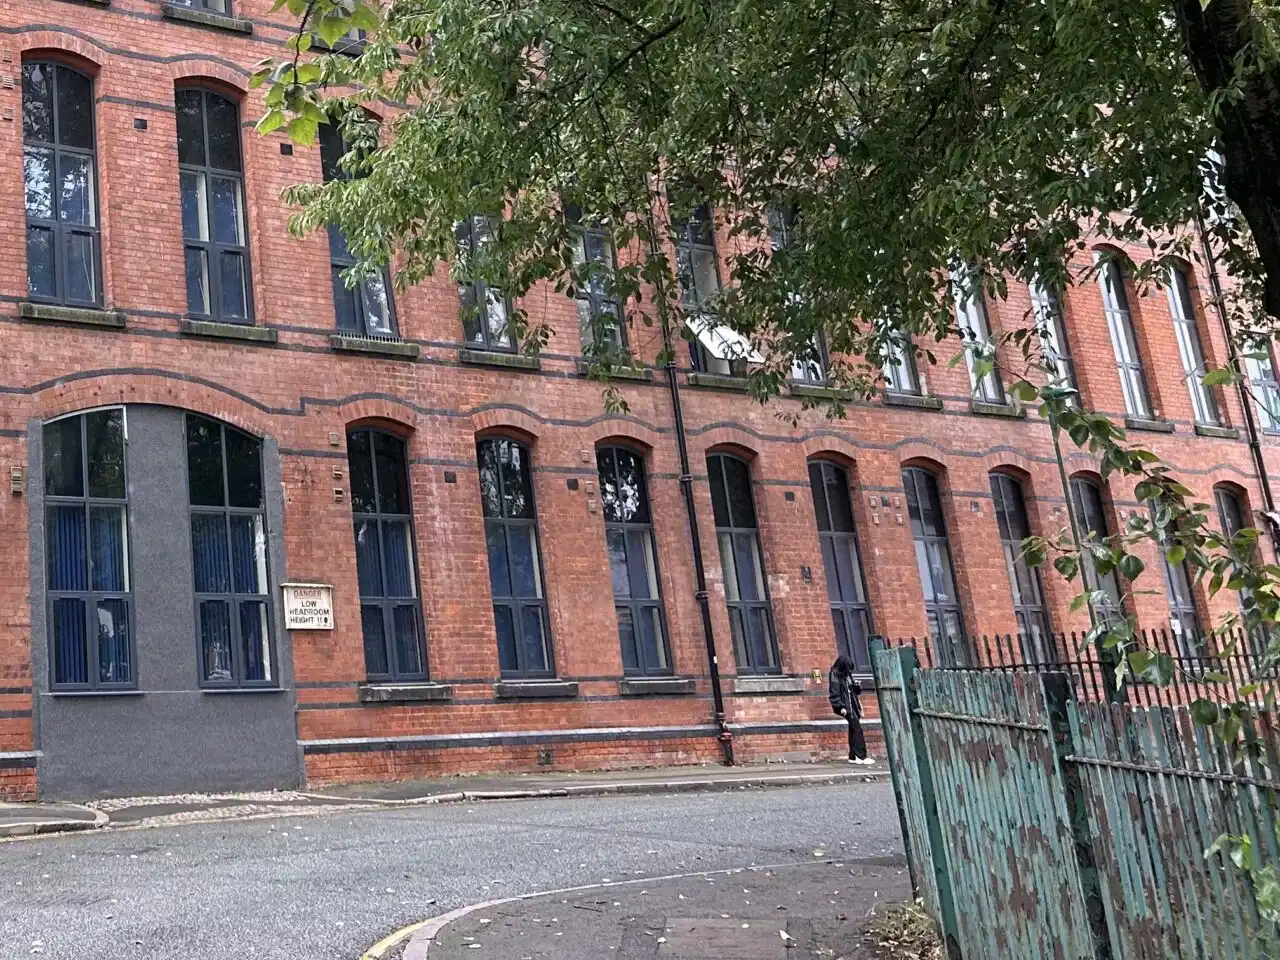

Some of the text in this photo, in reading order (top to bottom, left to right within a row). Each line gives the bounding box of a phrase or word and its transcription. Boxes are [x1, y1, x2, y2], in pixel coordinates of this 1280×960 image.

[293, 589, 322, 597] DANGER
[289, 608, 330, 616] HEADROOM
[290, 616, 314, 624] HEIGHT
